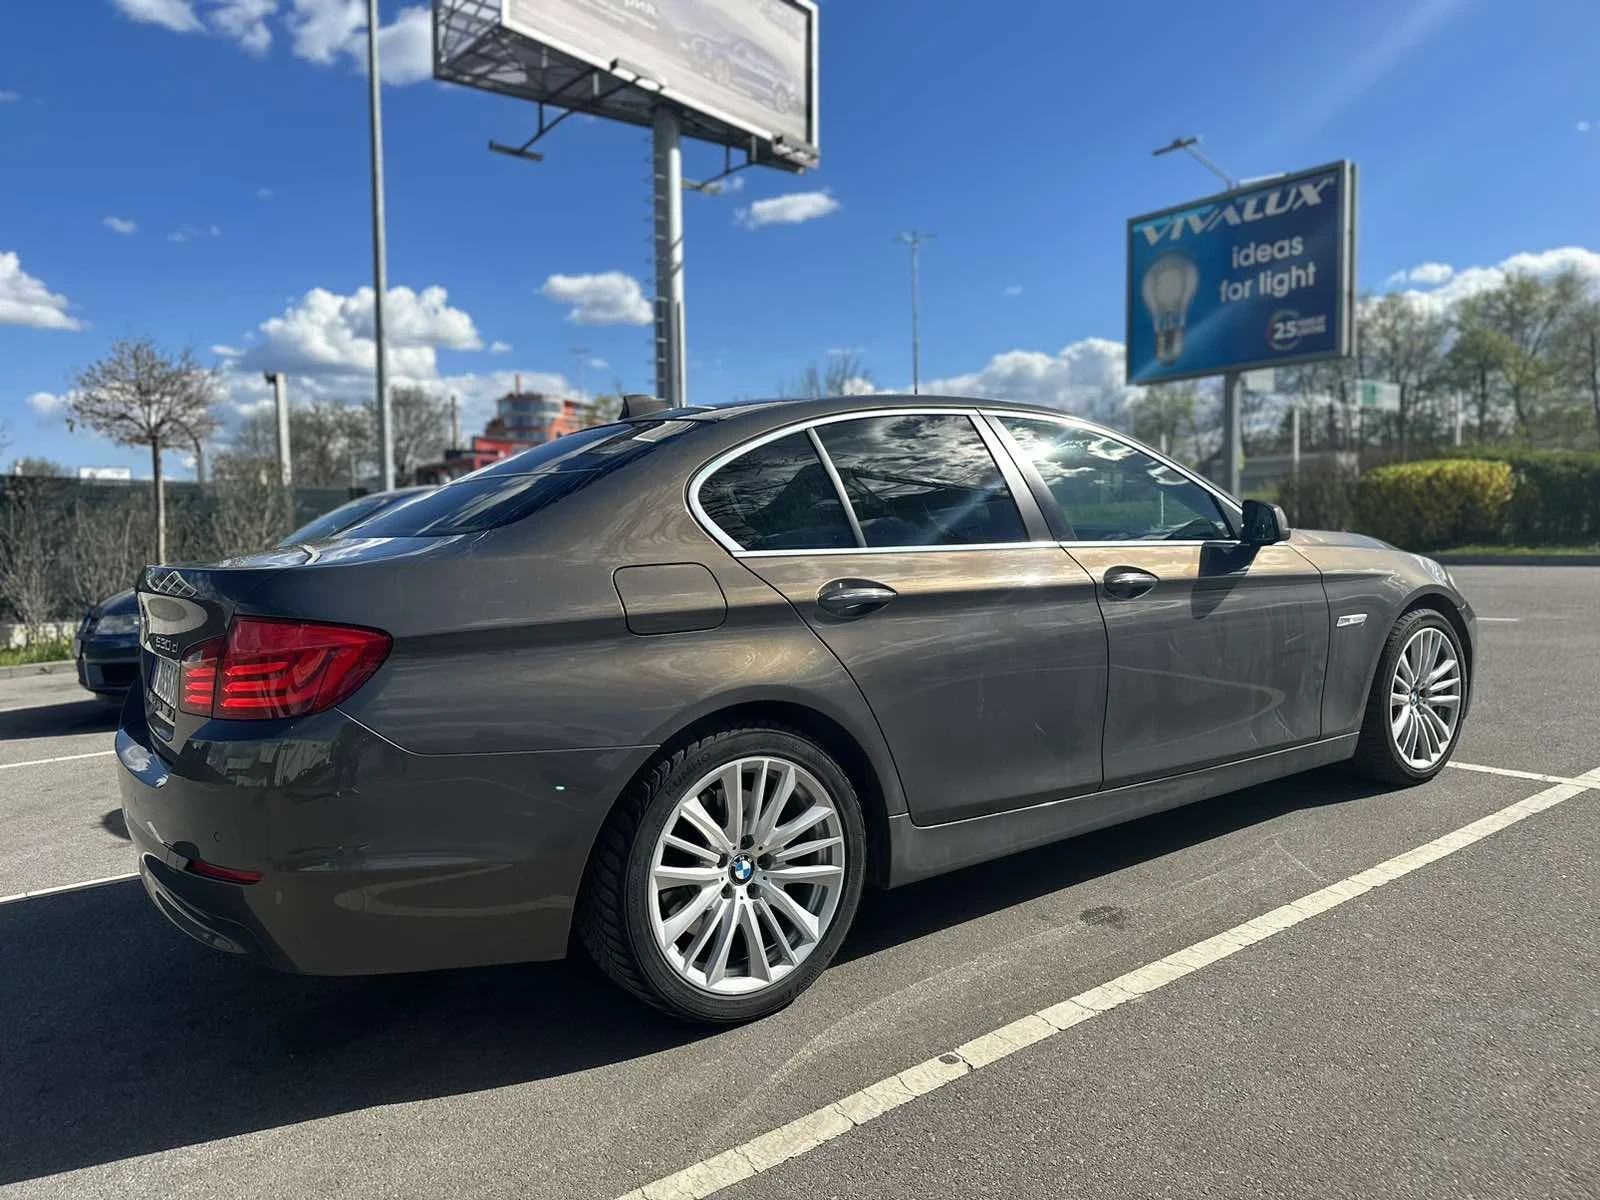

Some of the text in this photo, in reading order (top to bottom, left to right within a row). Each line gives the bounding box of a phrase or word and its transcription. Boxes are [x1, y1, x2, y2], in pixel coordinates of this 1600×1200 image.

[1142, 178, 1329, 246] VIVALUX
[1231, 235, 1304, 268] ideas
[1220, 262, 1317, 302] for light
[1273, 319, 1297, 340] 25
